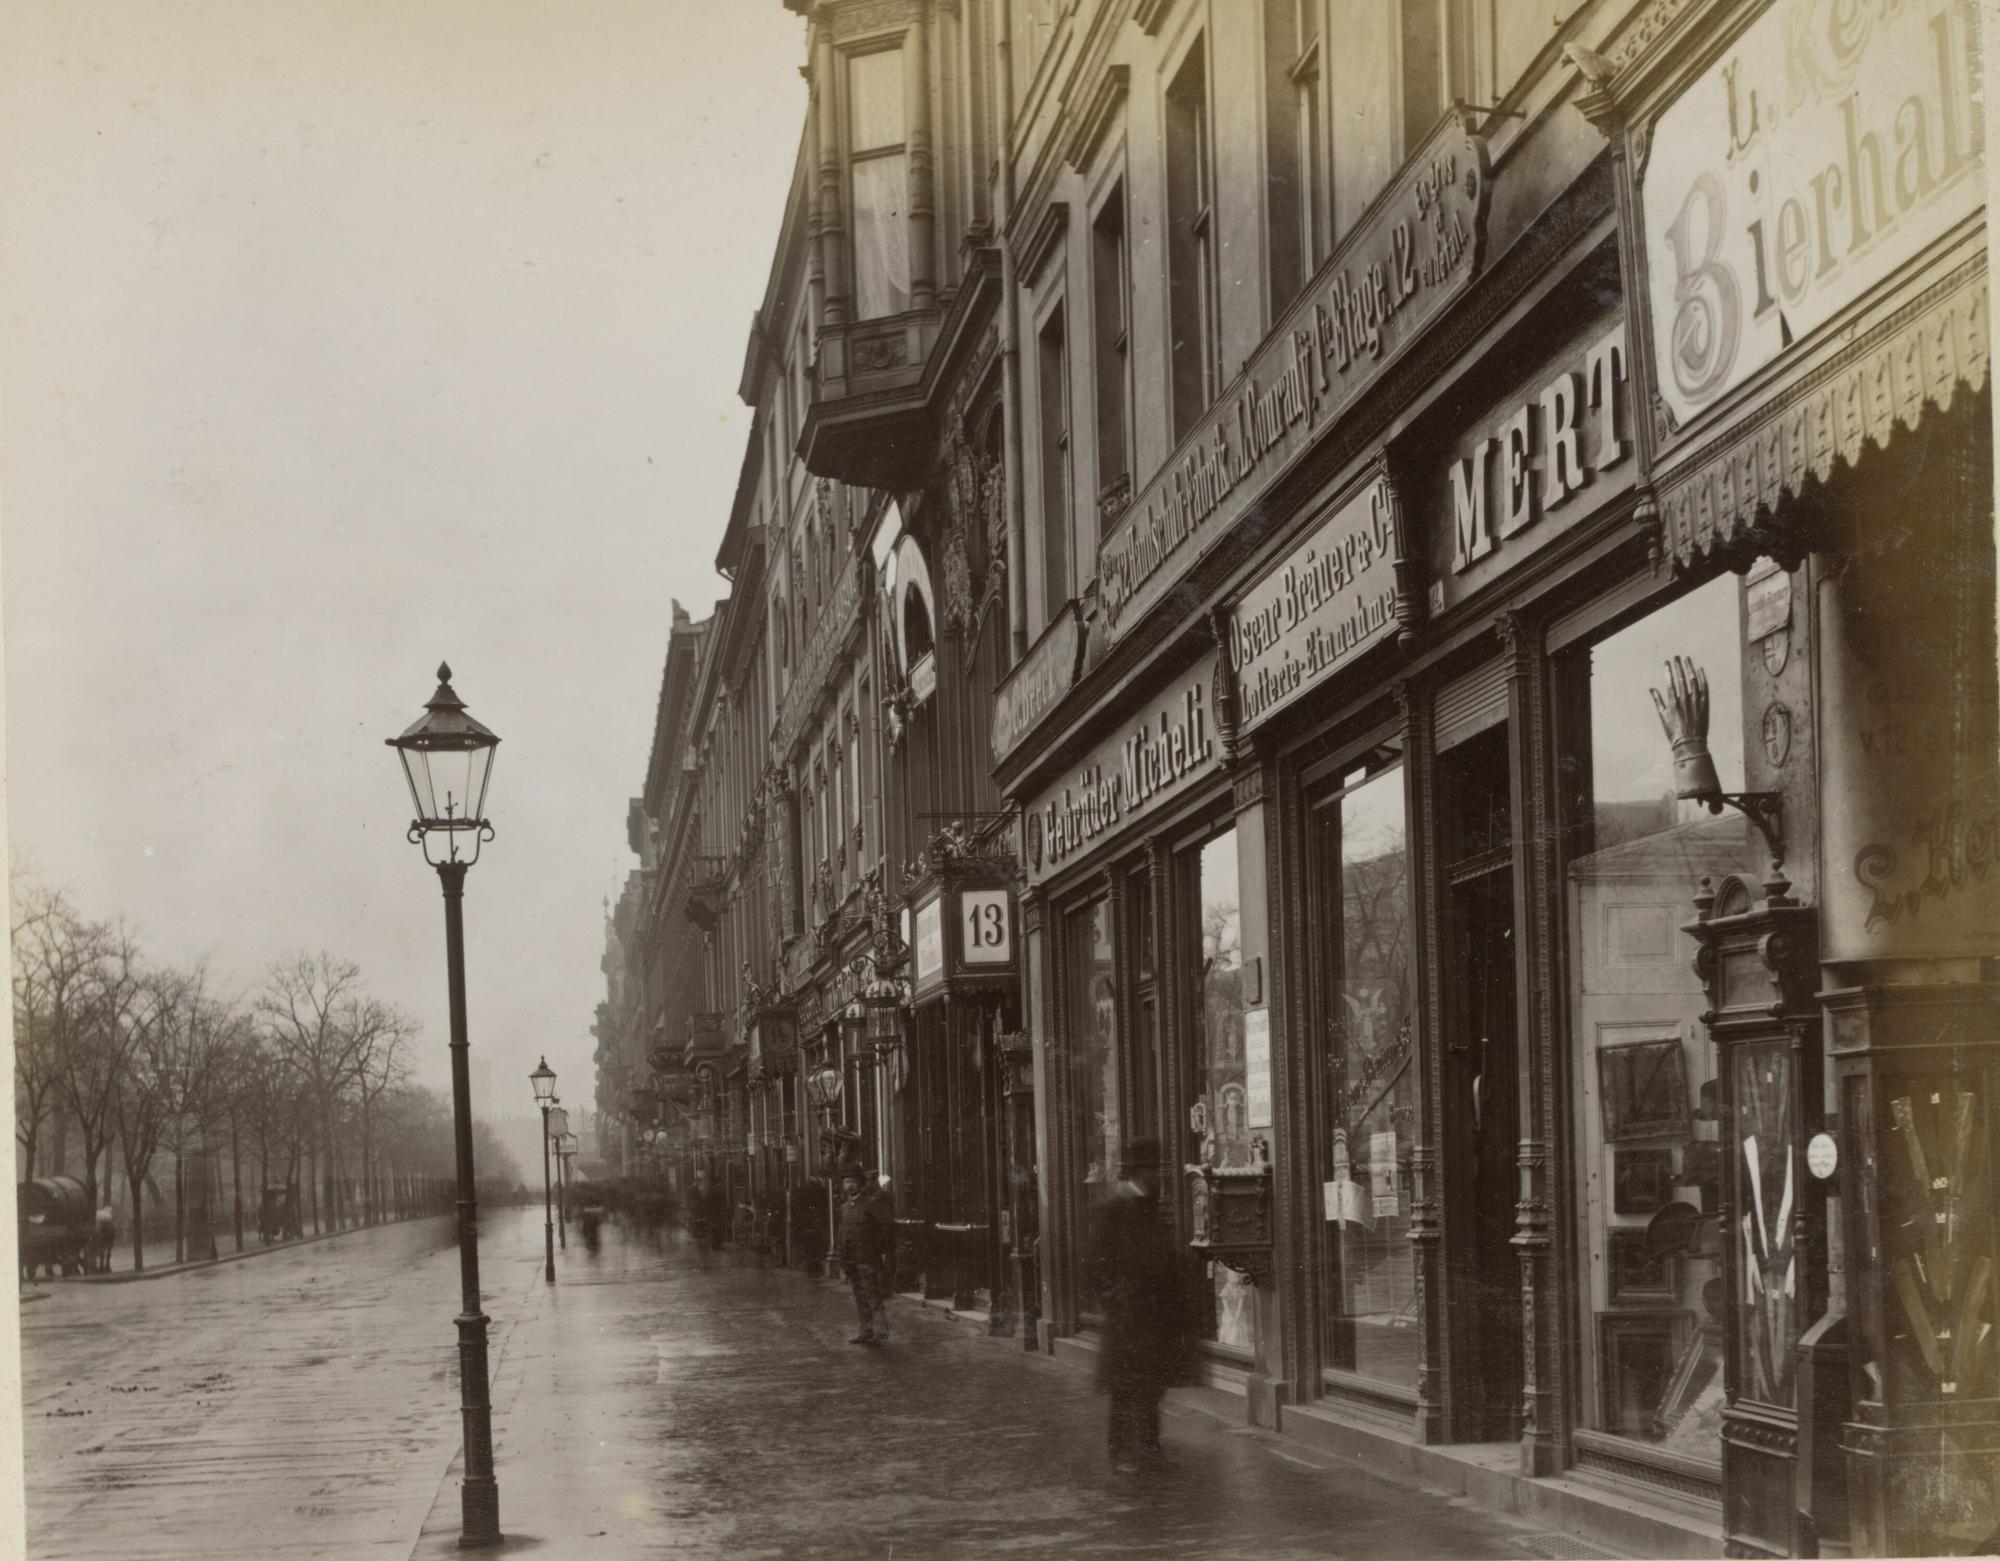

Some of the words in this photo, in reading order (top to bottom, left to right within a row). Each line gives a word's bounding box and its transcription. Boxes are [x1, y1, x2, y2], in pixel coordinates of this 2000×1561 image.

[1448, 318, 1628, 576] MERT
[1229, 600, 1282, 673] Oscar
[1281, 533, 1356, 633] Bräuer
[1356, 530, 1373, 573] &
[1239, 586, 1399, 728] Lotterie-Einnahme
[1044, 764, 1121, 863] Gebrüder
[968, 903, 1005, 948] 13
